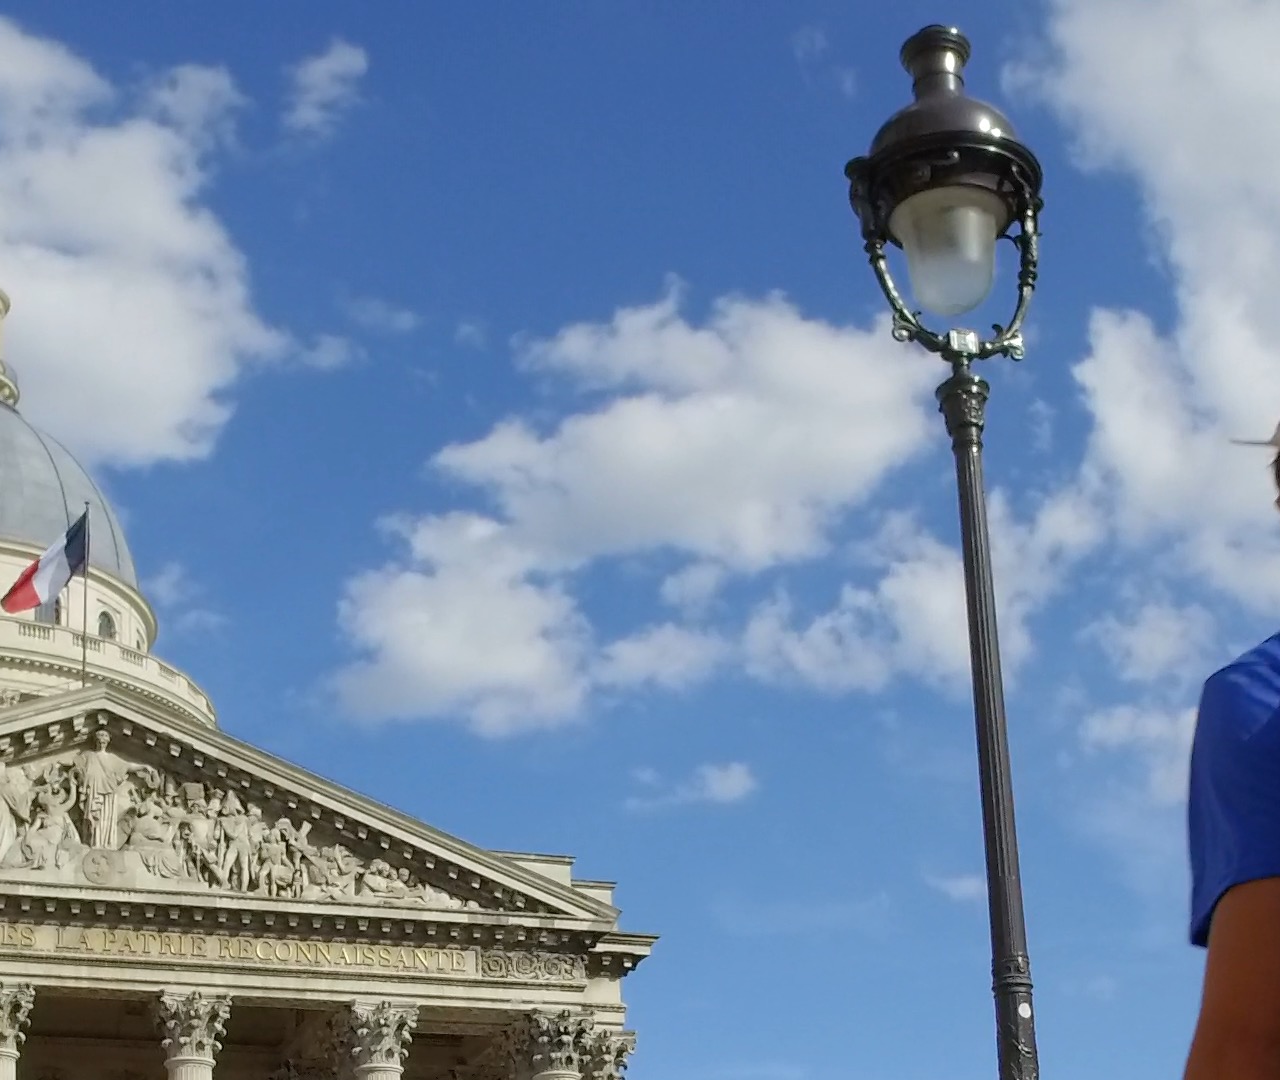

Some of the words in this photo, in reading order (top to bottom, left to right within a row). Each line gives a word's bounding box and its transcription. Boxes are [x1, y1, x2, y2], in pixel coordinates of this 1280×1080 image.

[55, 926, 94, 951] LA
[103, 930, 207, 957] PATRIE
[218, 937, 467, 972] RECONNAISSANTE
